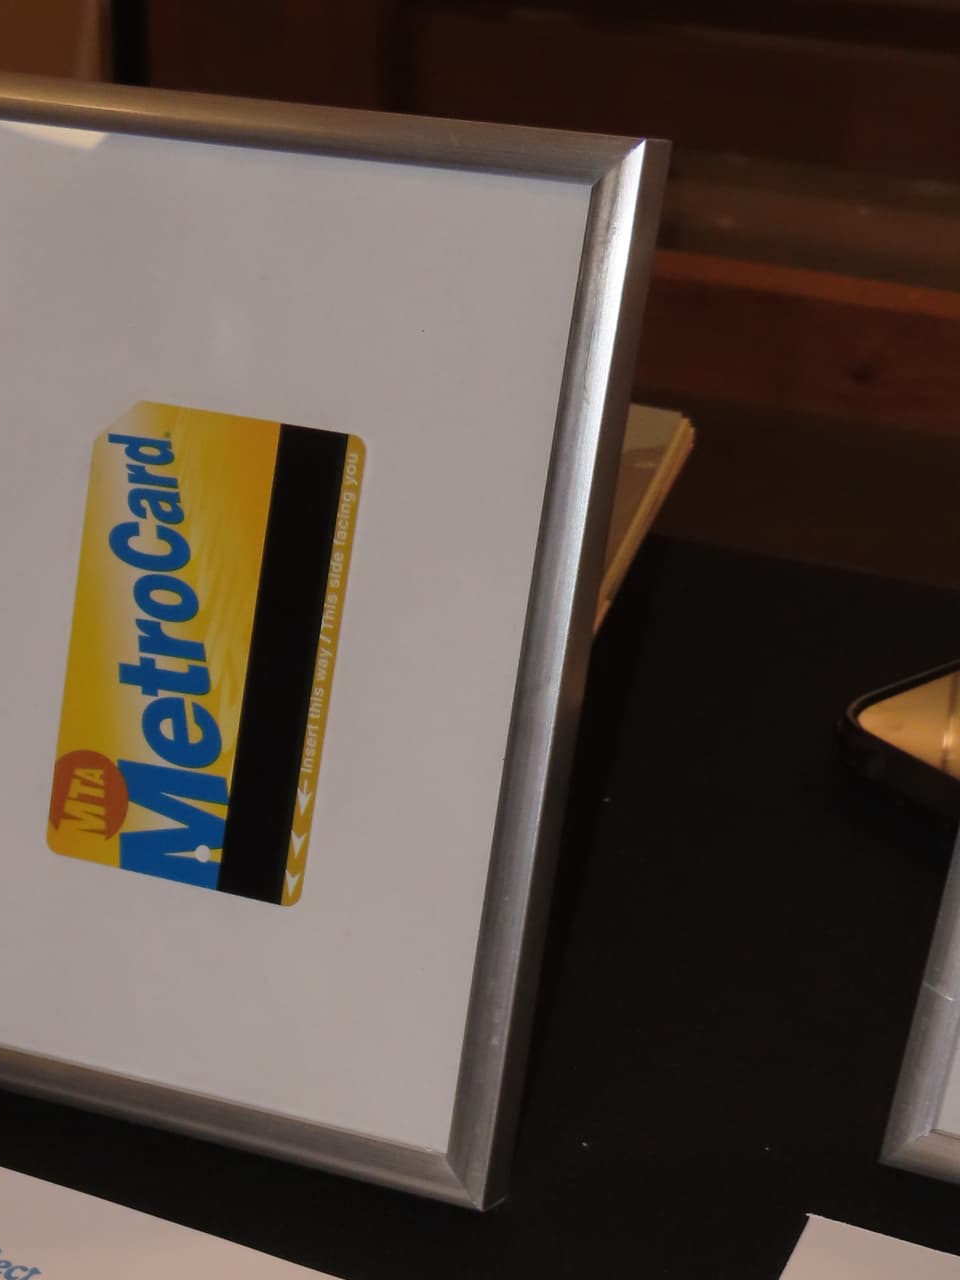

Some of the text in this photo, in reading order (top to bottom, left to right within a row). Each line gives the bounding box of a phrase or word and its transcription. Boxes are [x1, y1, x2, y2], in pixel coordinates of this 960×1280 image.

[346, 453, 359, 487] you
[333, 491, 357, 545] facing
[329, 552, 345, 589] side
[321, 592, 339, 632] This
[317, 647, 333, 682] way
[309, 687, 325, 719] this
[301, 724, 320, 774] Insert
[61, 767, 107, 838] MTA
